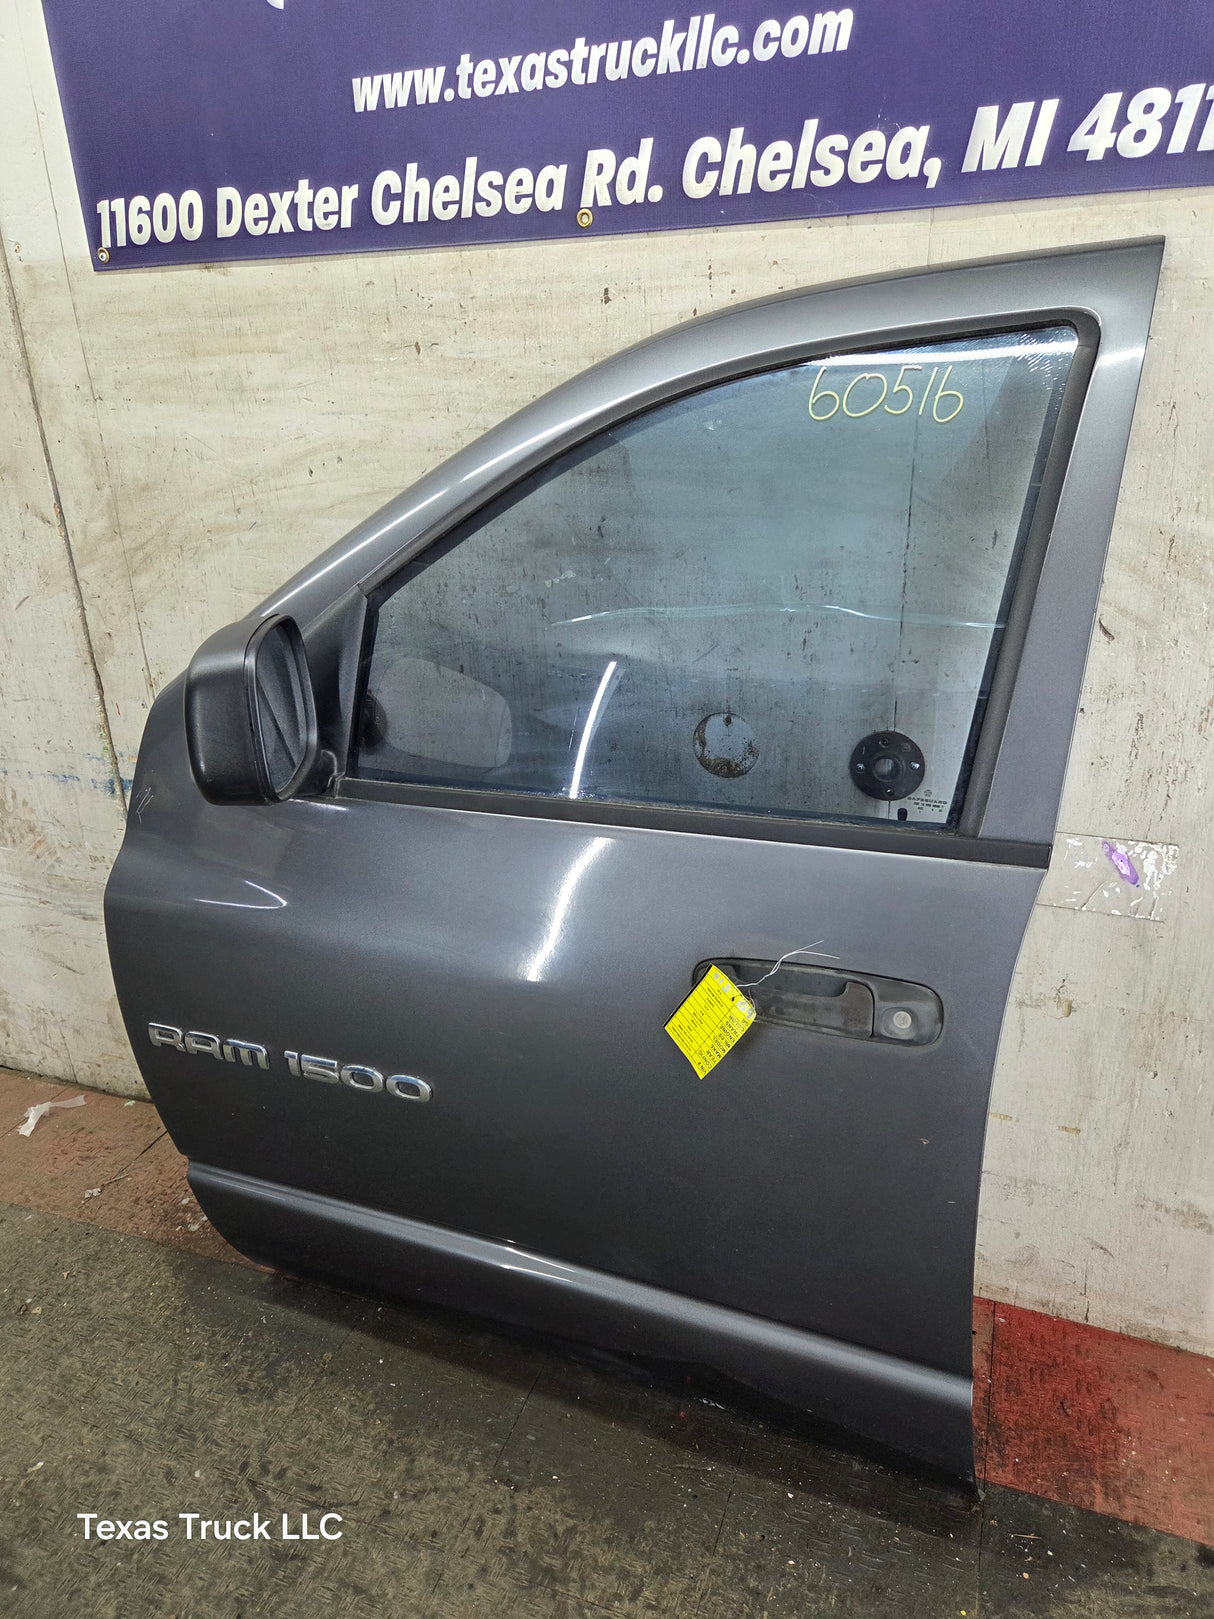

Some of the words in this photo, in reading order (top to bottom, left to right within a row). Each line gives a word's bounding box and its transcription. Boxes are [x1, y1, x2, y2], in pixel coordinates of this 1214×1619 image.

[352, 7, 854, 113] www.texastruckllc.com
[96, 190, 204, 249] 11600
[216, 179, 359, 239] Dexter
[371, 156, 568, 226] Chelsea
[580, 136, 663, 208] Rd.
[682, 119, 931, 199] Chelsea,
[961, 98, 1060, 173] MI
[808, 365, 963, 423] 60516
[711, 1034, 727, 1054] MODEL
[719, 1023, 736, 1043] ENGINE
[725, 1020, 739, 1038] TRANS
[148, 1022, 270, 1070] RAM
[283, 1050, 434, 1102] 1500
[709, 1043, 722, 1059] MAKE
